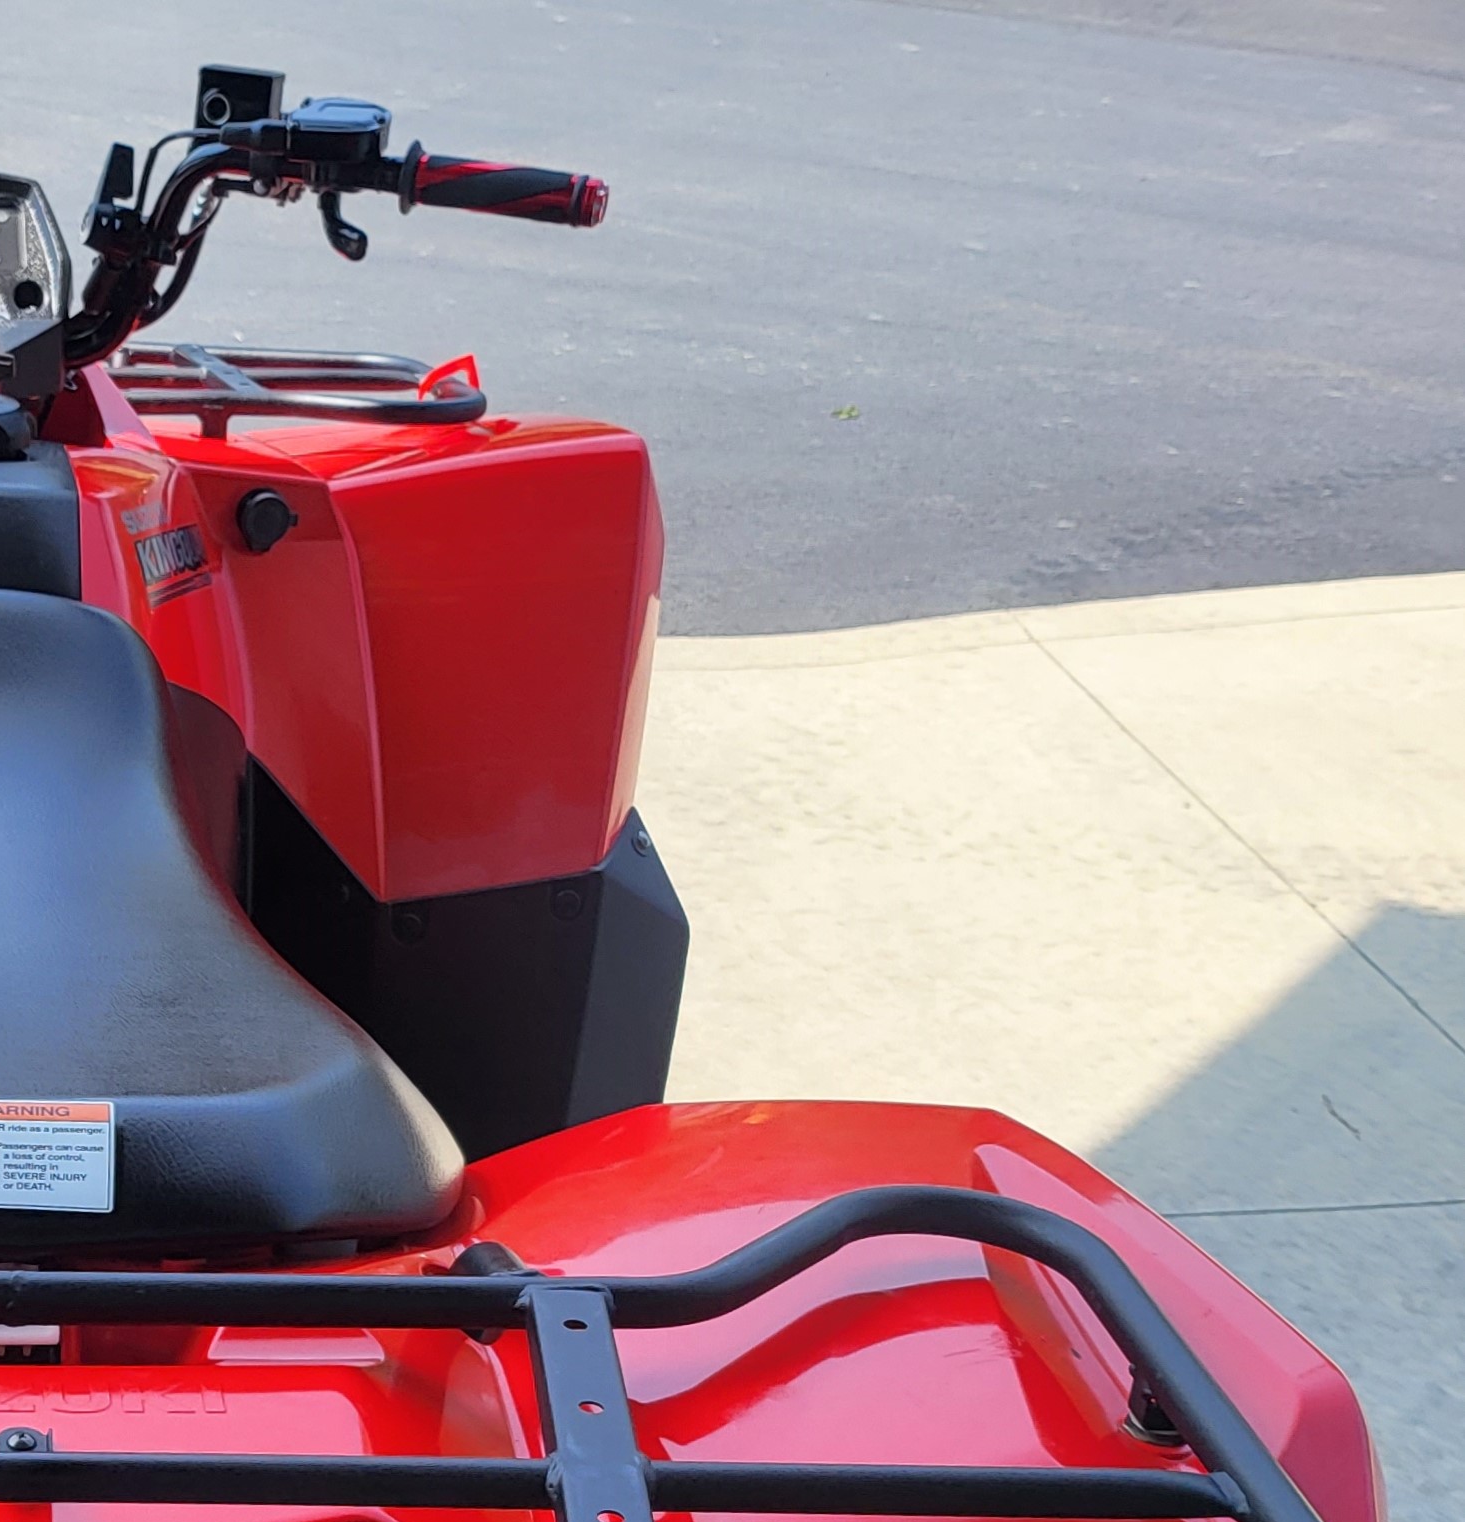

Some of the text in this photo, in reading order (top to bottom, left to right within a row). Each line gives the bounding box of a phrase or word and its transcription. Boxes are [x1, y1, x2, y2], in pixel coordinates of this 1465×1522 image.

[8, 1124, 27, 1132] ride
[52, 1126, 105, 1135] passenger.
[55, 1144, 73, 1152] can
[12, 1152, 33, 1160] loss
[3, 1162, 59, 1172] resulting in
[3, 1172, 87, 1181] SEVERE INJURY
[3, 1182, 14, 1190] or
